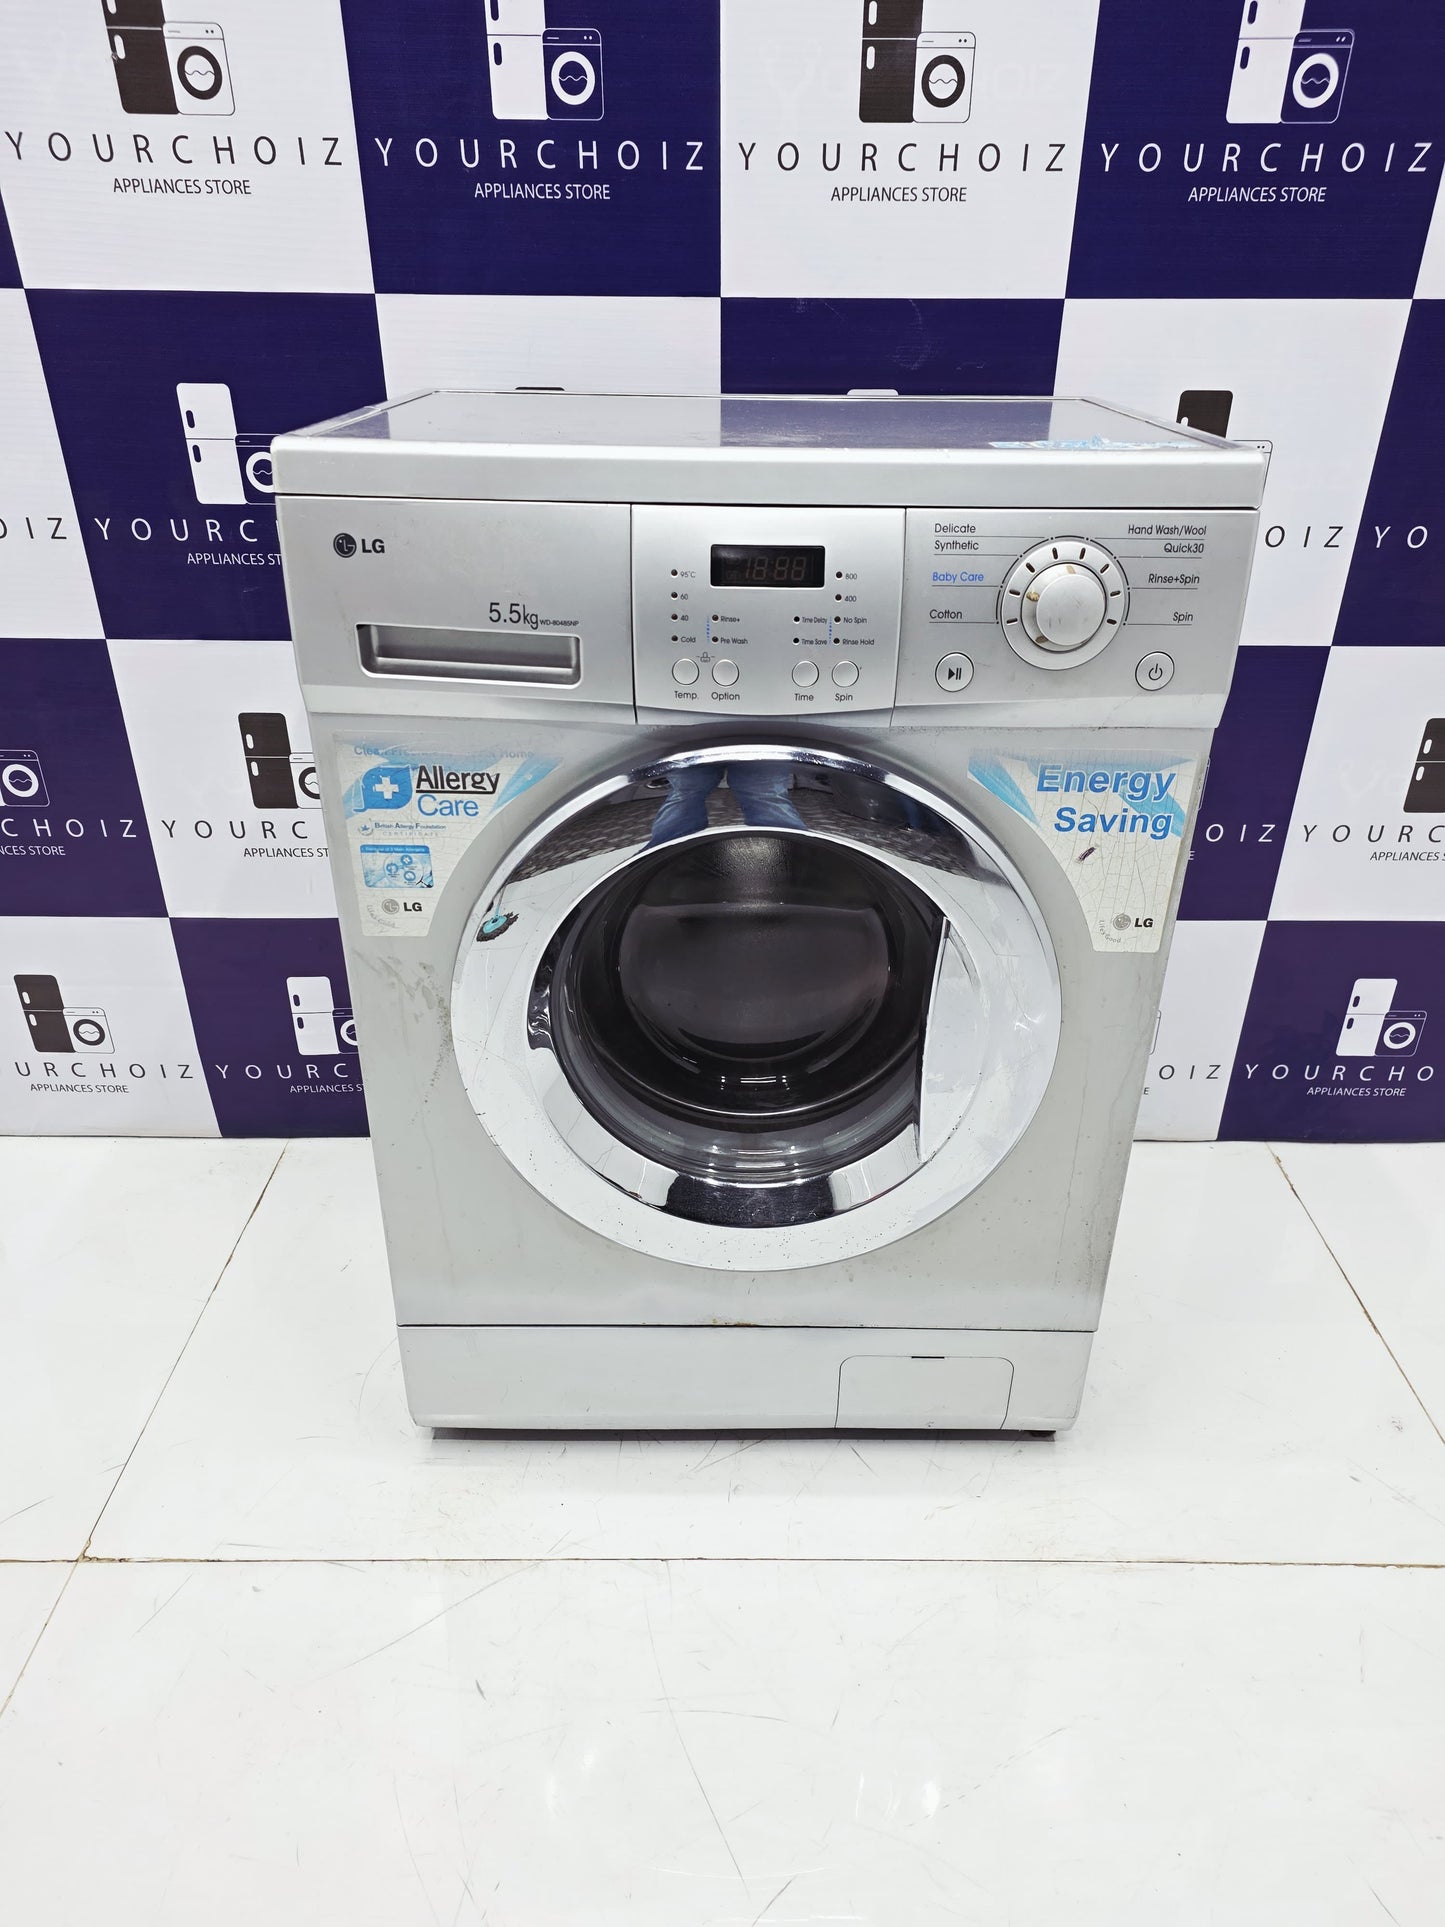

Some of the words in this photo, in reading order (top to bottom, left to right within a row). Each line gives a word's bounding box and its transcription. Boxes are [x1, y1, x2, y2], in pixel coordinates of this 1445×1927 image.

[5, 131, 343, 166] YOURCHOIZ
[374, 137, 704, 170] YOURCHOIZ
[738, 142, 1066, 172] YOURCHOIZ
[1101, 142, 1433, 172] YOURCHOIZ
[113, 177, 202, 194] APPLIANCES
[205, 179, 252, 195] STORE
[474, 182, 562, 199] APPLIANCES
[565, 184, 611, 200] STORE
[831, 187, 918, 202] APPLIANCES
[921, 187, 968, 202] STORE
[1188, 187, 1277, 202] APPLIANCES
[1279, 187, 1328, 203] STORE
[94, 518, 280, 543] YOURC
[934, 523, 976, 534] Delicate
[1127, 524, 1153, 536] Hand
[1154, 524, 1207, 537] Wash/Wool
[361, 538, 386, 554] LG
[934, 540, 979, 551] Synthetic
[1163, 542, 1205, 554] Quick30
[187, 552, 265, 565] APPLIANCES
[932, 571, 958, 584] Baby
[960, 571, 985, 583] Care
[1148, 573, 1200, 586] Rinse+Spin
[680, 592, 689, 601] 60
[844, 595, 857, 603] 400
[488, 601, 539, 631] 5.5kg
[680, 614, 689, 622] 40
[801, 616, 813, 624] Time
[814, 616, 828, 625] Delay
[843, 616, 853, 624] No
[854, 616, 868, 625] Spin
[929, 609, 963, 620] Cotton
[1172, 611, 1194, 624] Spin
[680, 635, 696, 644] Cold
[720, 637, 731, 645] Pre
[732, 637, 748, 645] Wash
[860, 638, 875, 646] Hold
[711, 690, 740, 702] Option
[794, 693, 814, 702] Time
[834, 692, 853, 703] Spin
[415, 765, 501, 794] Allergy
[1036, 763, 1177, 802] Energy
[417, 793, 480, 817] Care
[1053, 806, 1173, 841] Saving
[28, 845, 67, 856] STORE
[243, 847, 314, 858] APPLIANCES
[1369, 851, 1440, 862] APPLIANCES
[403, 902, 423, 912] LG
[1134, 917, 1154, 928] LG
[30, 1083, 94, 1093] APPLIANCES
[95, 1084, 130, 1094] STORE
[289, 1083, 354, 1094] APPLIANCES
[1306, 1086, 1371, 1097] APPLIANCES
[1373, 1087, 1407, 1097] STORE
